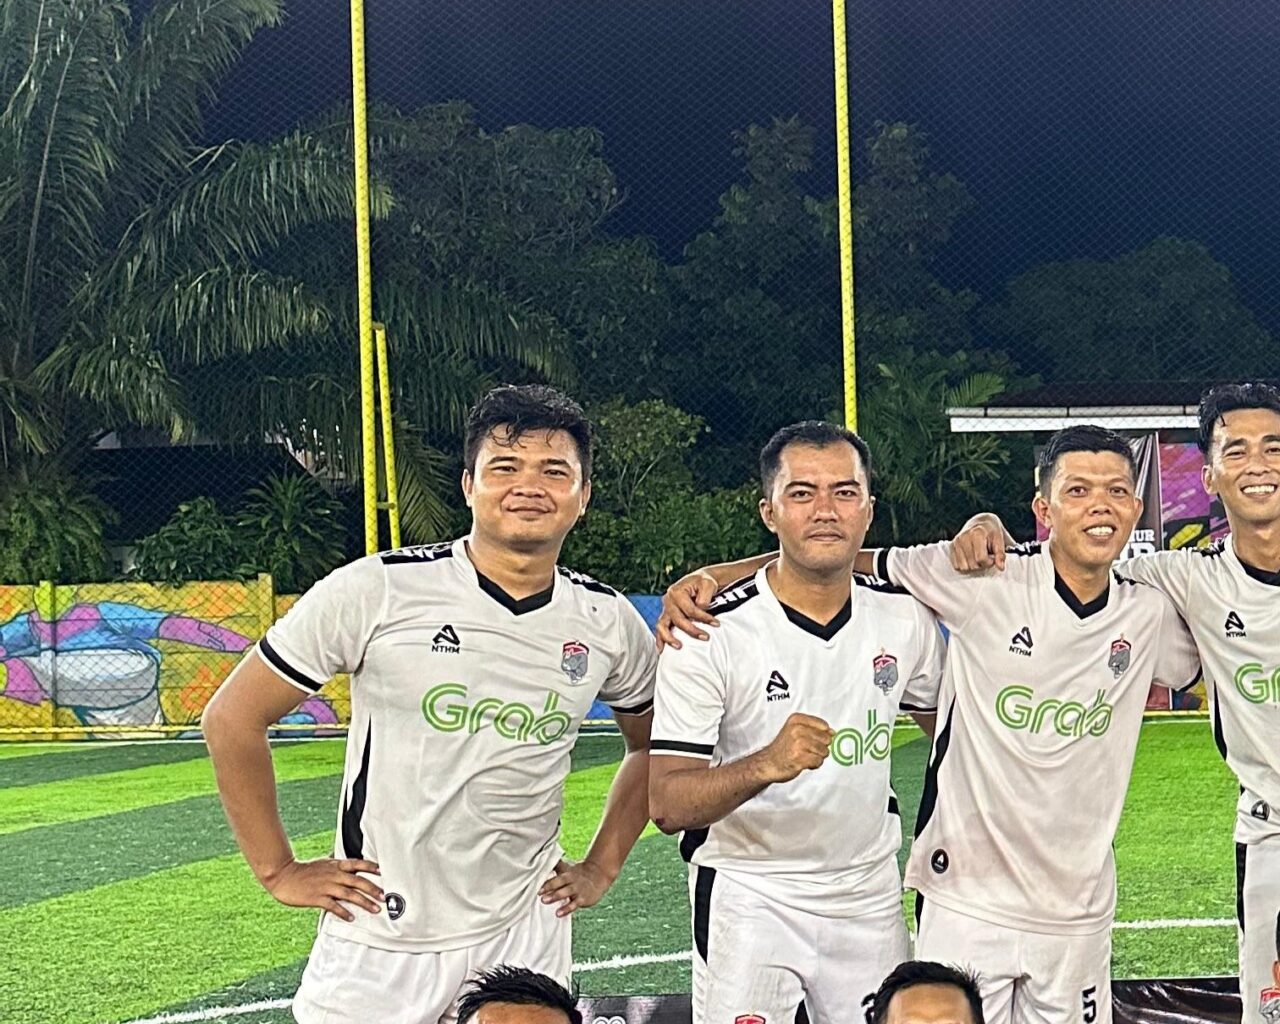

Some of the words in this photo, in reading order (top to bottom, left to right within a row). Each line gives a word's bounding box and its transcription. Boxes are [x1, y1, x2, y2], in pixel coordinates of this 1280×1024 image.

[431, 645, 460, 654] NTHM
[421, 683, 571, 745] Grab
[766, 692, 790, 702] NTHM
[995, 688, 1113, 737] Grab
[831, 709, 890, 767] ab
[1082, 986, 1097, 1023] 5
